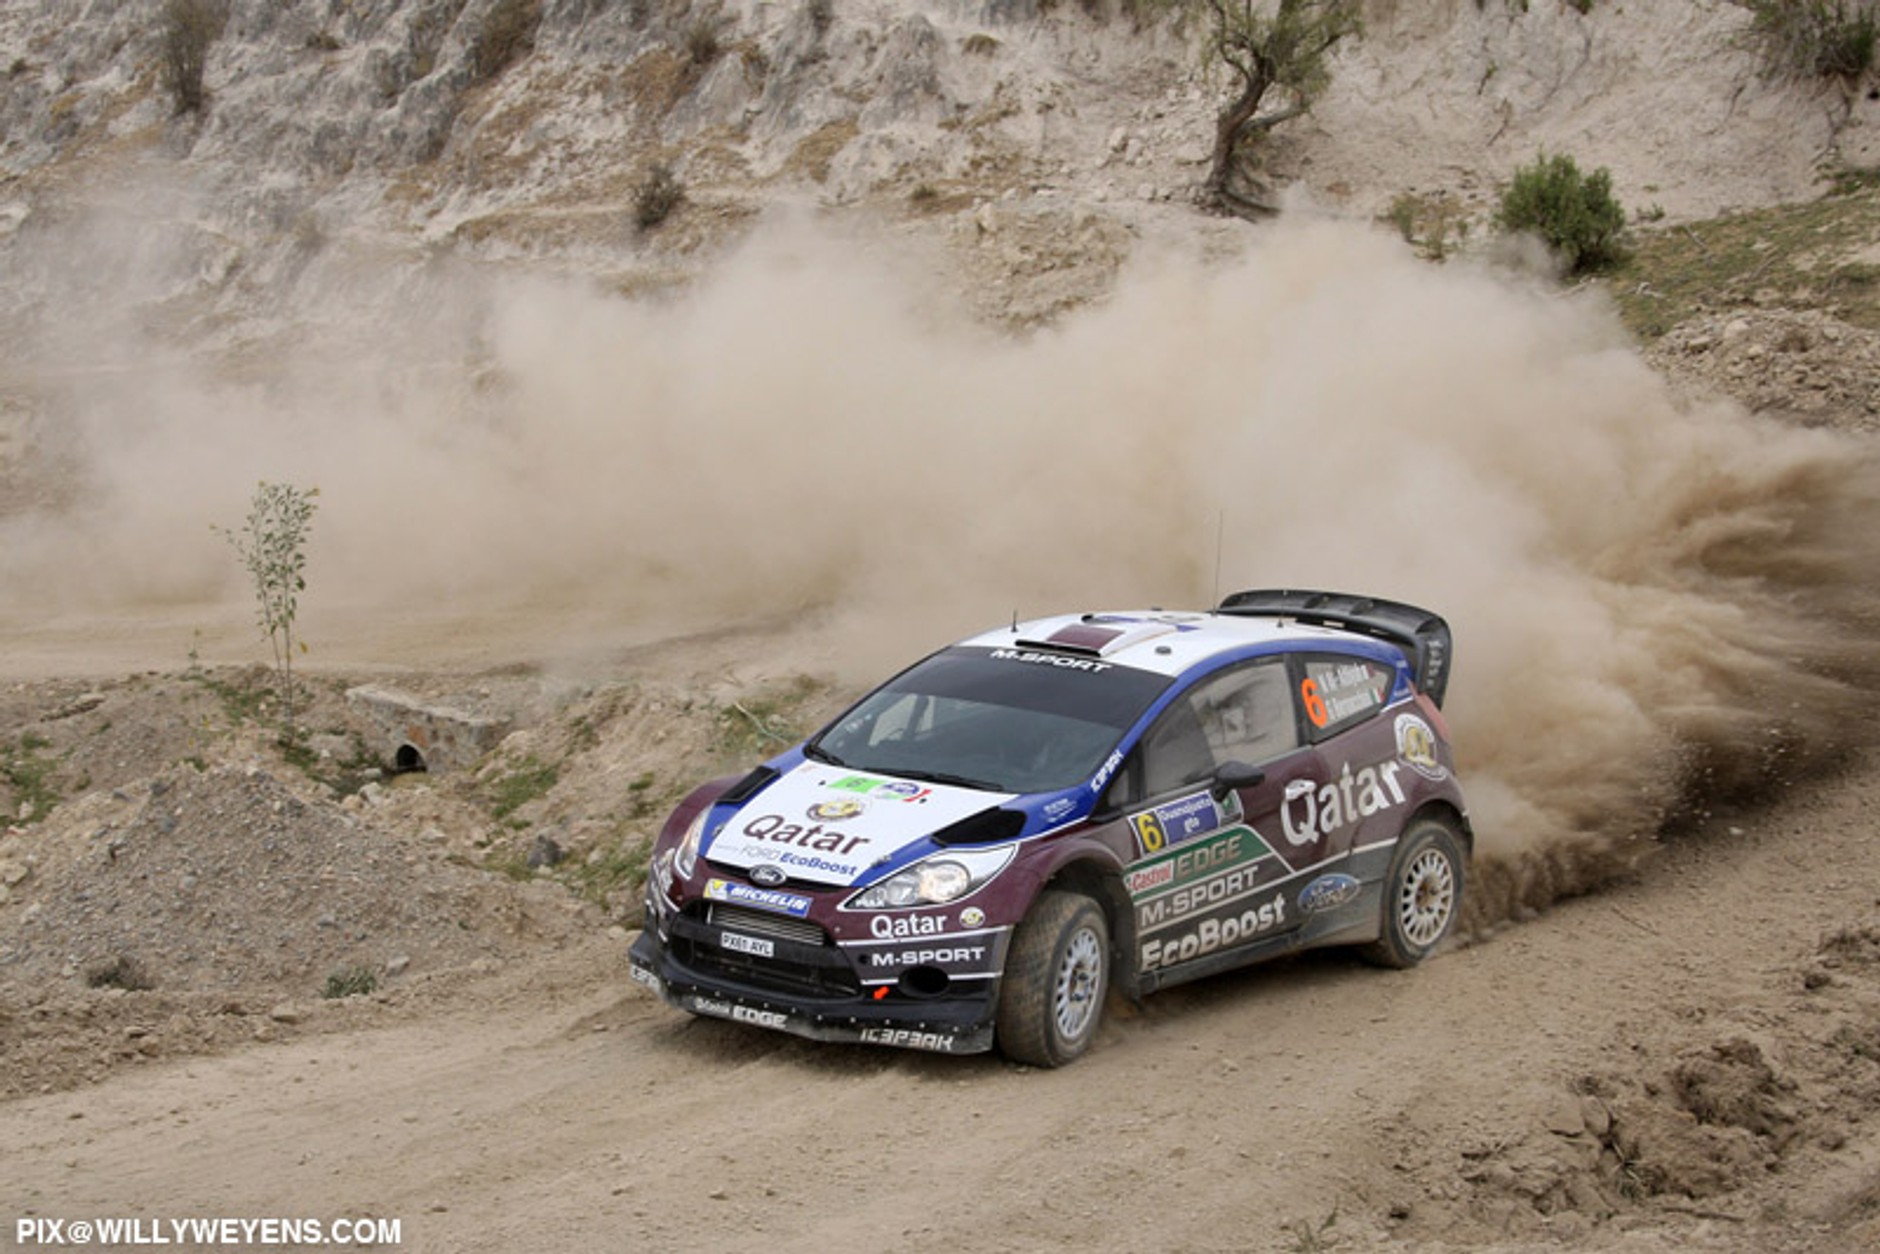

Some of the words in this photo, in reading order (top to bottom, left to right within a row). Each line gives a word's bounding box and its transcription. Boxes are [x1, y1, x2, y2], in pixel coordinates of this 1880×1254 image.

[989, 649, 1112, 673] M-SPORT
[1301, 678, 1328, 729] 6
[1281, 760, 1406, 847] Qatar
[743, 814, 871, 855] Qatar
[1137, 814, 1163, 853] 6
[780, 852, 857, 876] EcoBoost
[1176, 834, 1242, 881] EDGE
[731, 887, 808, 910] MICHELIN
[1141, 865, 1259, 927] M-SPORT
[870, 913, 948, 939] Qatar
[1141, 892, 1287, 974] EcoBoost
[872, 946, 986, 967] M-SPORT
[733, 1005, 788, 1029] EDGE
